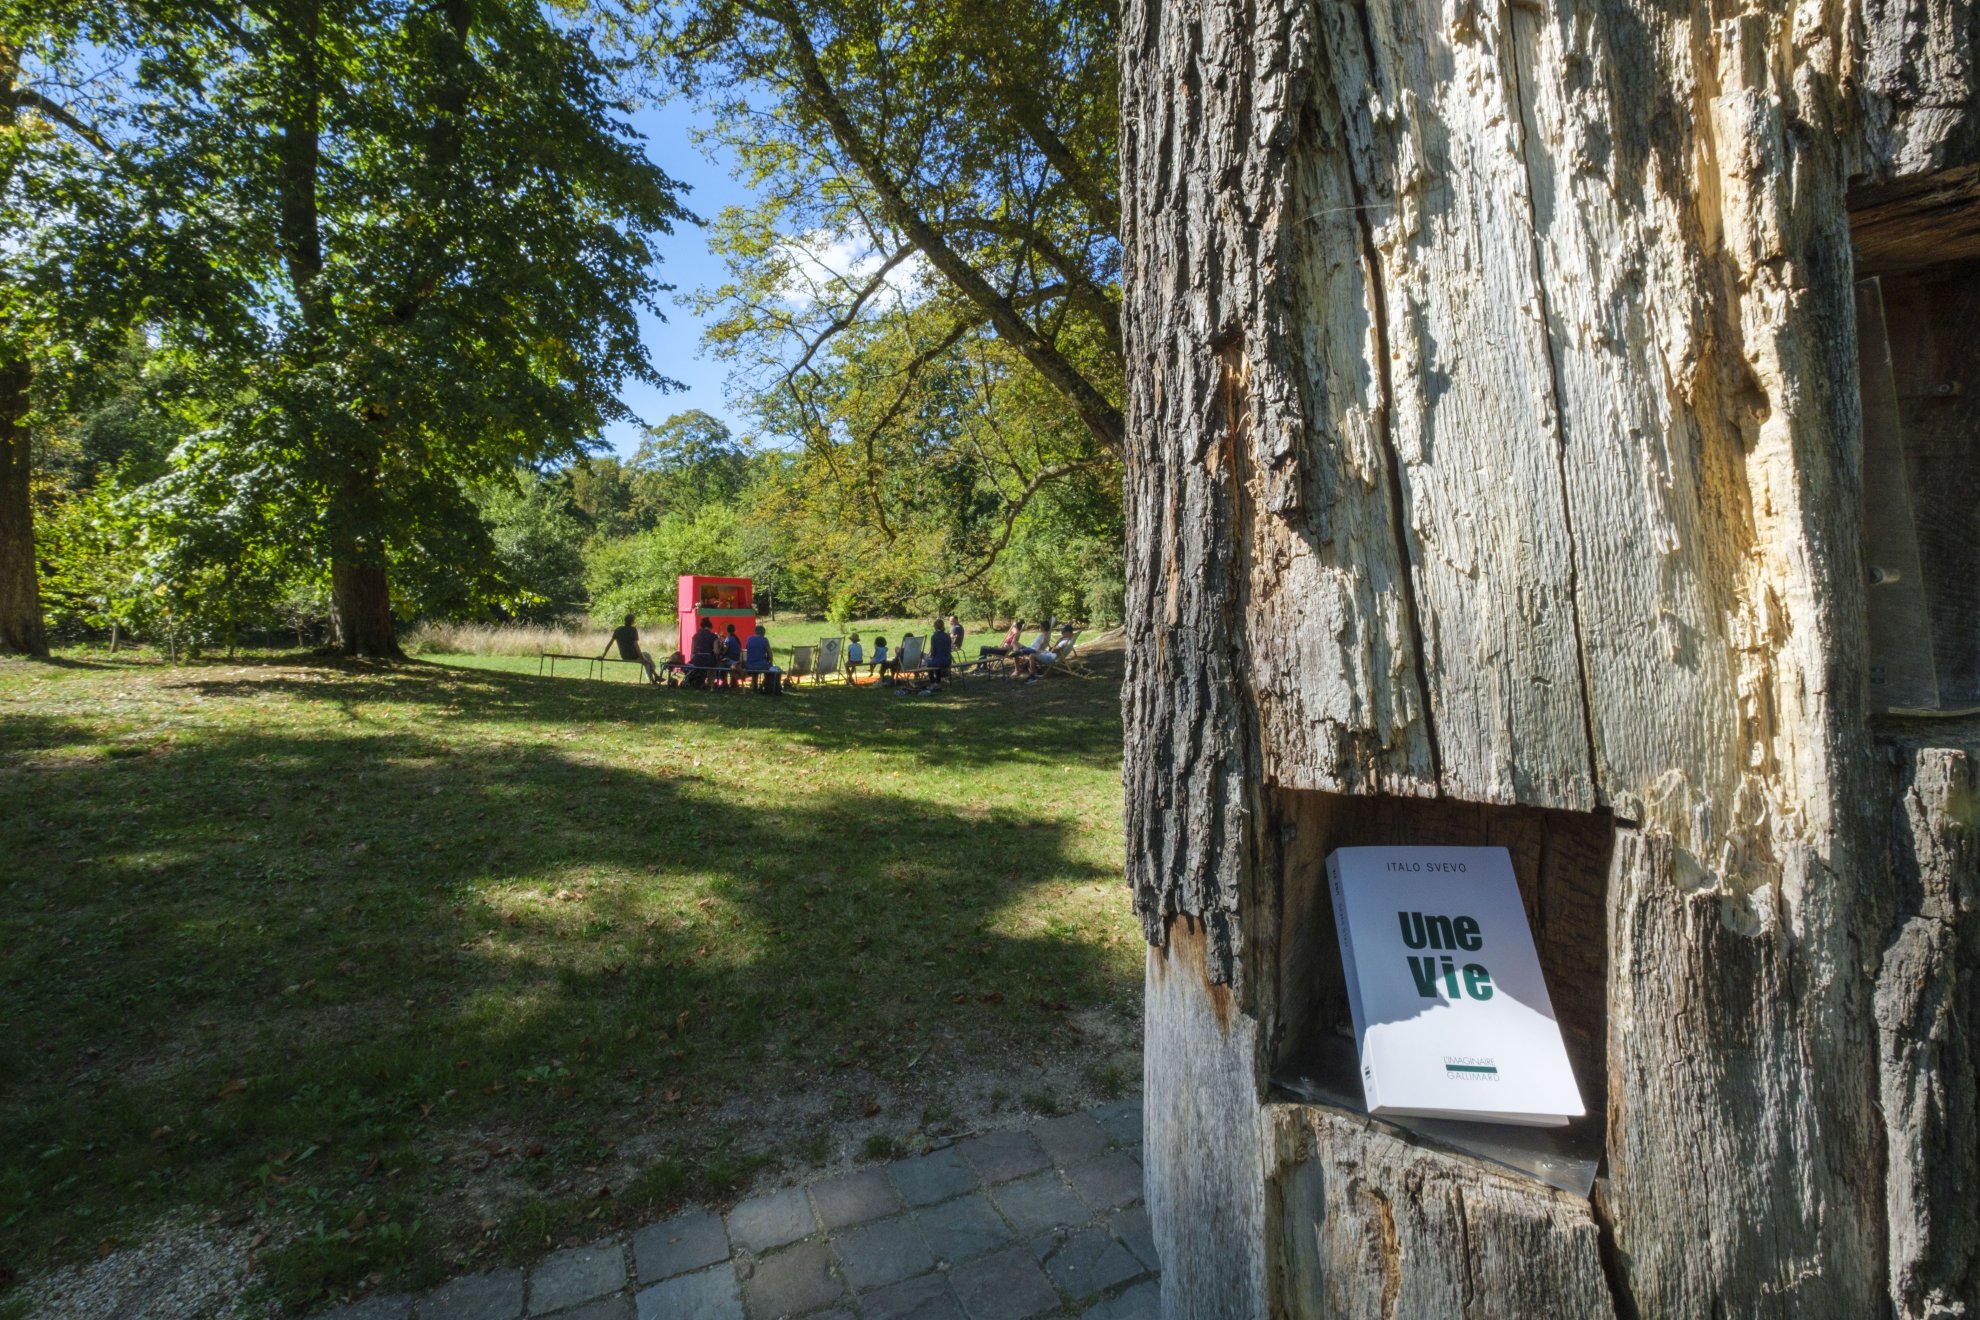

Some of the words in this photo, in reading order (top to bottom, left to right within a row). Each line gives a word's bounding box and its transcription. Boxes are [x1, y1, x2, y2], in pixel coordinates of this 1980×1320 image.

[1386, 862, 1421, 873] ITALO
[1426, 862, 1467, 873] SVEVO
[1398, 911, 1483, 952] Une
[1406, 955, 1494, 1002] Vie
[1443, 1055, 1496, 1067] L'IMAGINAIRE
[1446, 1071, 1500, 1082] GALLIMARD
